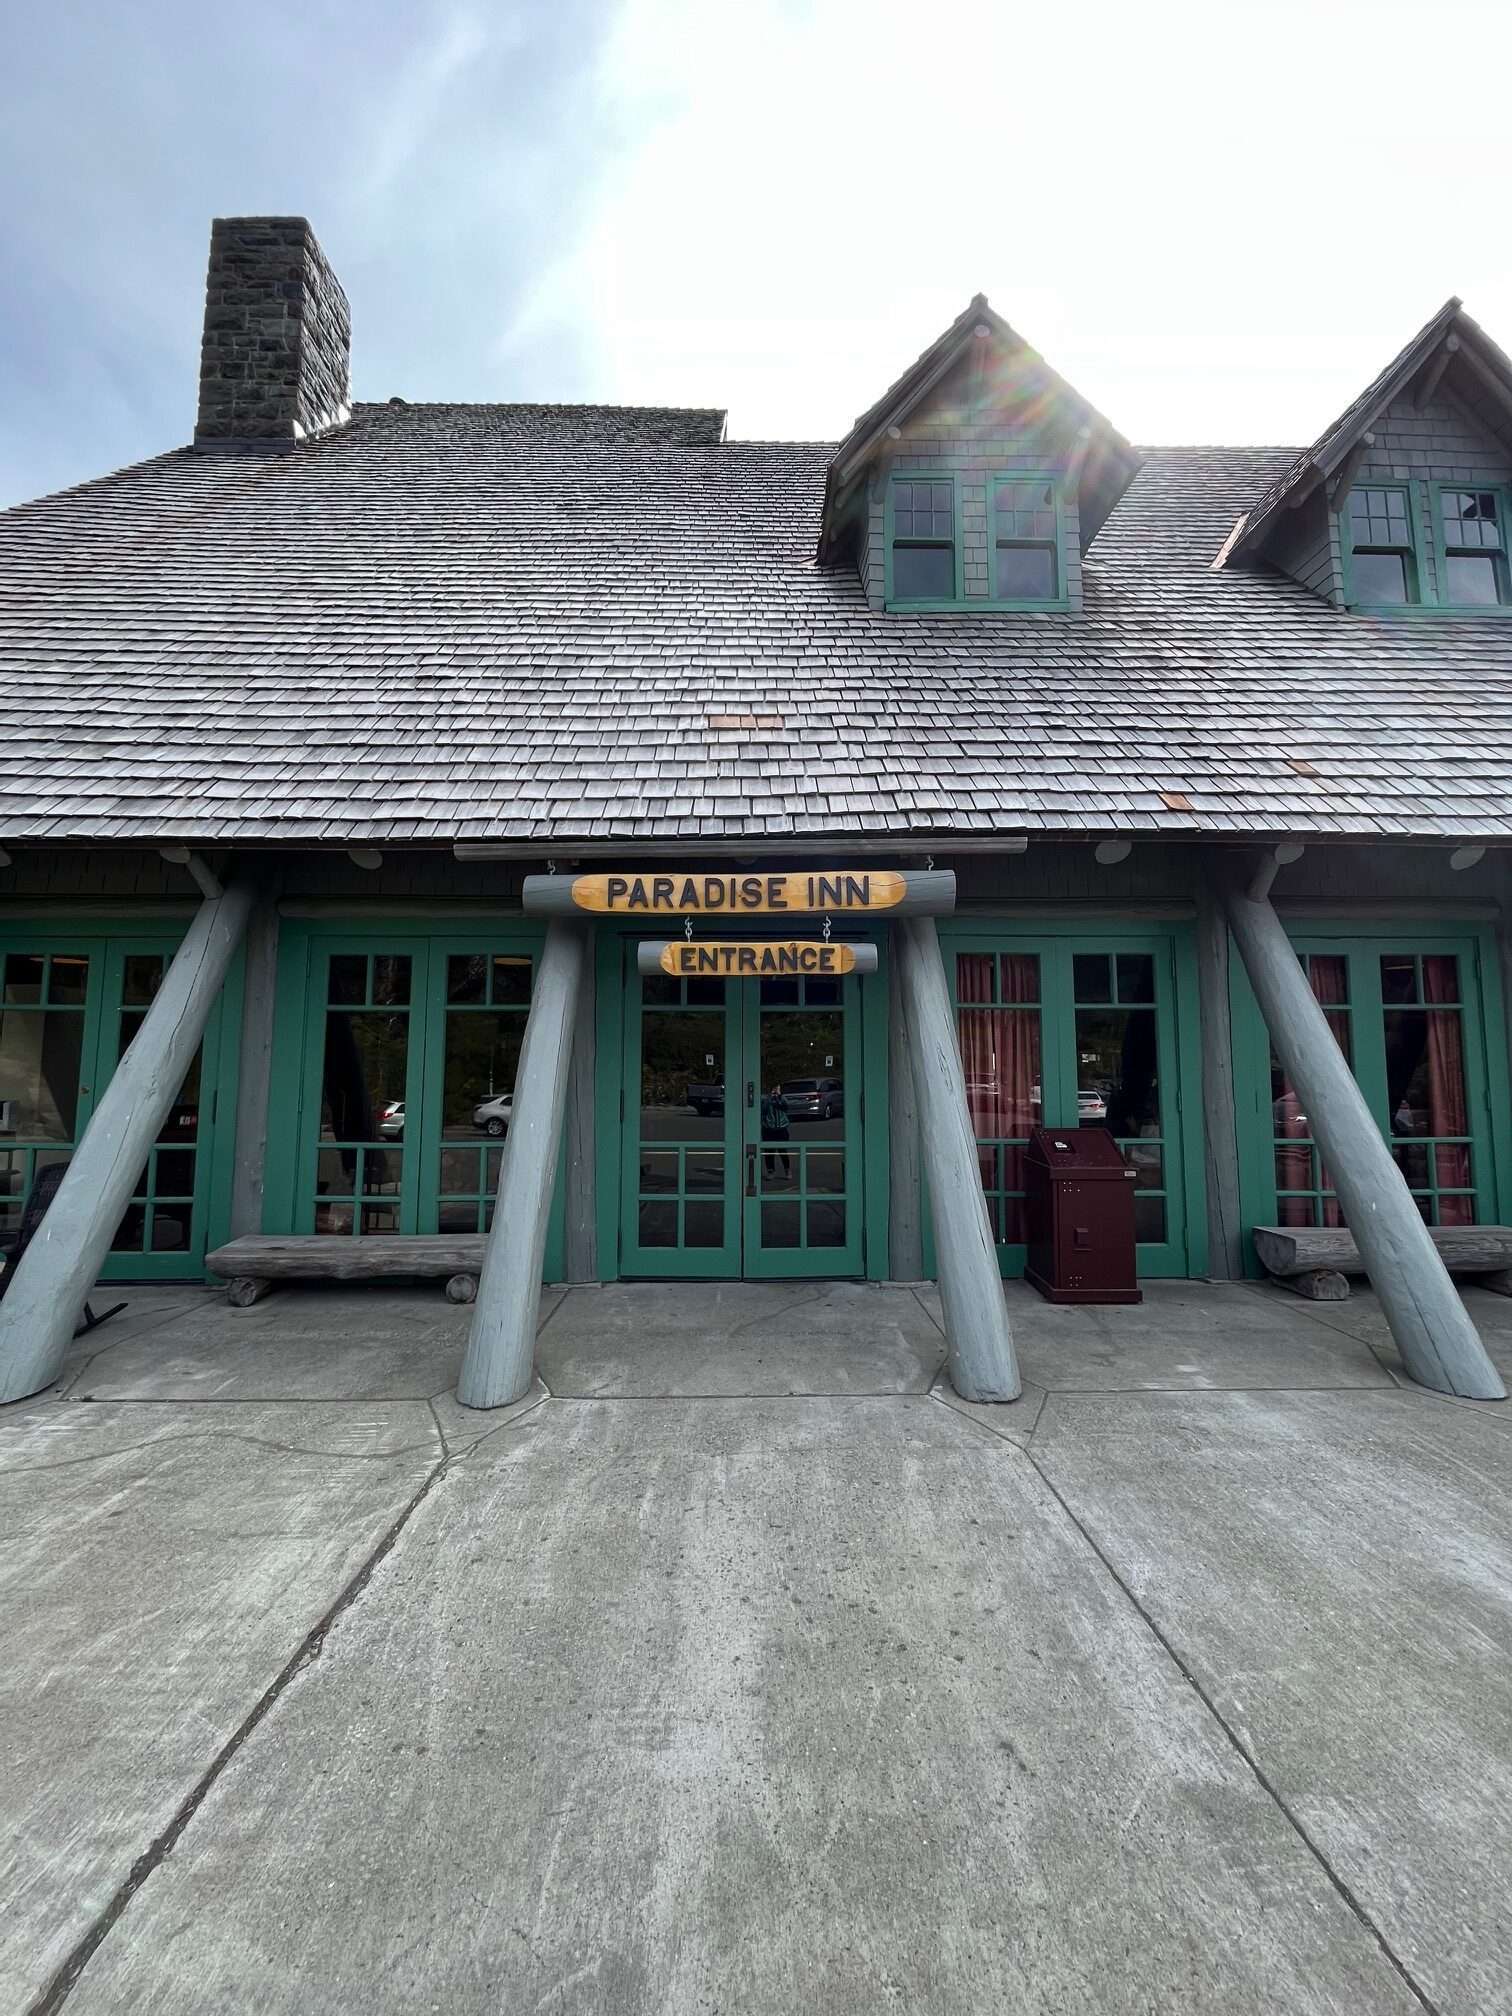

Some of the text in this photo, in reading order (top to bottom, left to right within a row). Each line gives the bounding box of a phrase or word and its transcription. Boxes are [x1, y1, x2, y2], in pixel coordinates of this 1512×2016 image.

[608, 876, 870, 908] PARADISE INN
[680, 947, 835, 972] ENTRANCE
